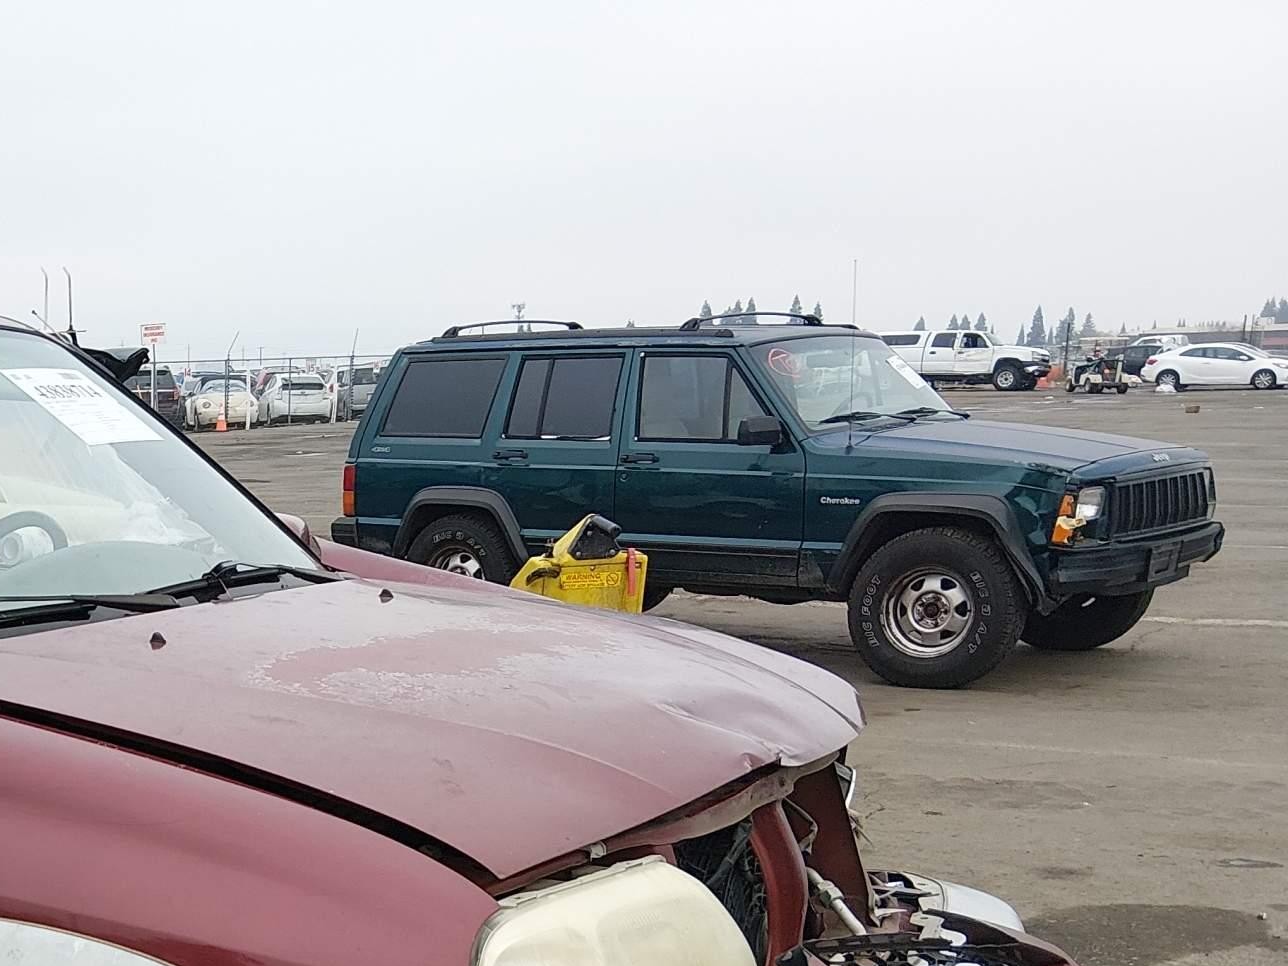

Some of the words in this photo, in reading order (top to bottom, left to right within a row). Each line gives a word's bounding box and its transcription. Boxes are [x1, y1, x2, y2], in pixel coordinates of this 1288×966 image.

[33, 384, 103, 399] 43838714
[820, 496, 860, 505] Cherokee
[565, 573, 601, 581] WARNING
[861, 574, 882, 616] FOOT
